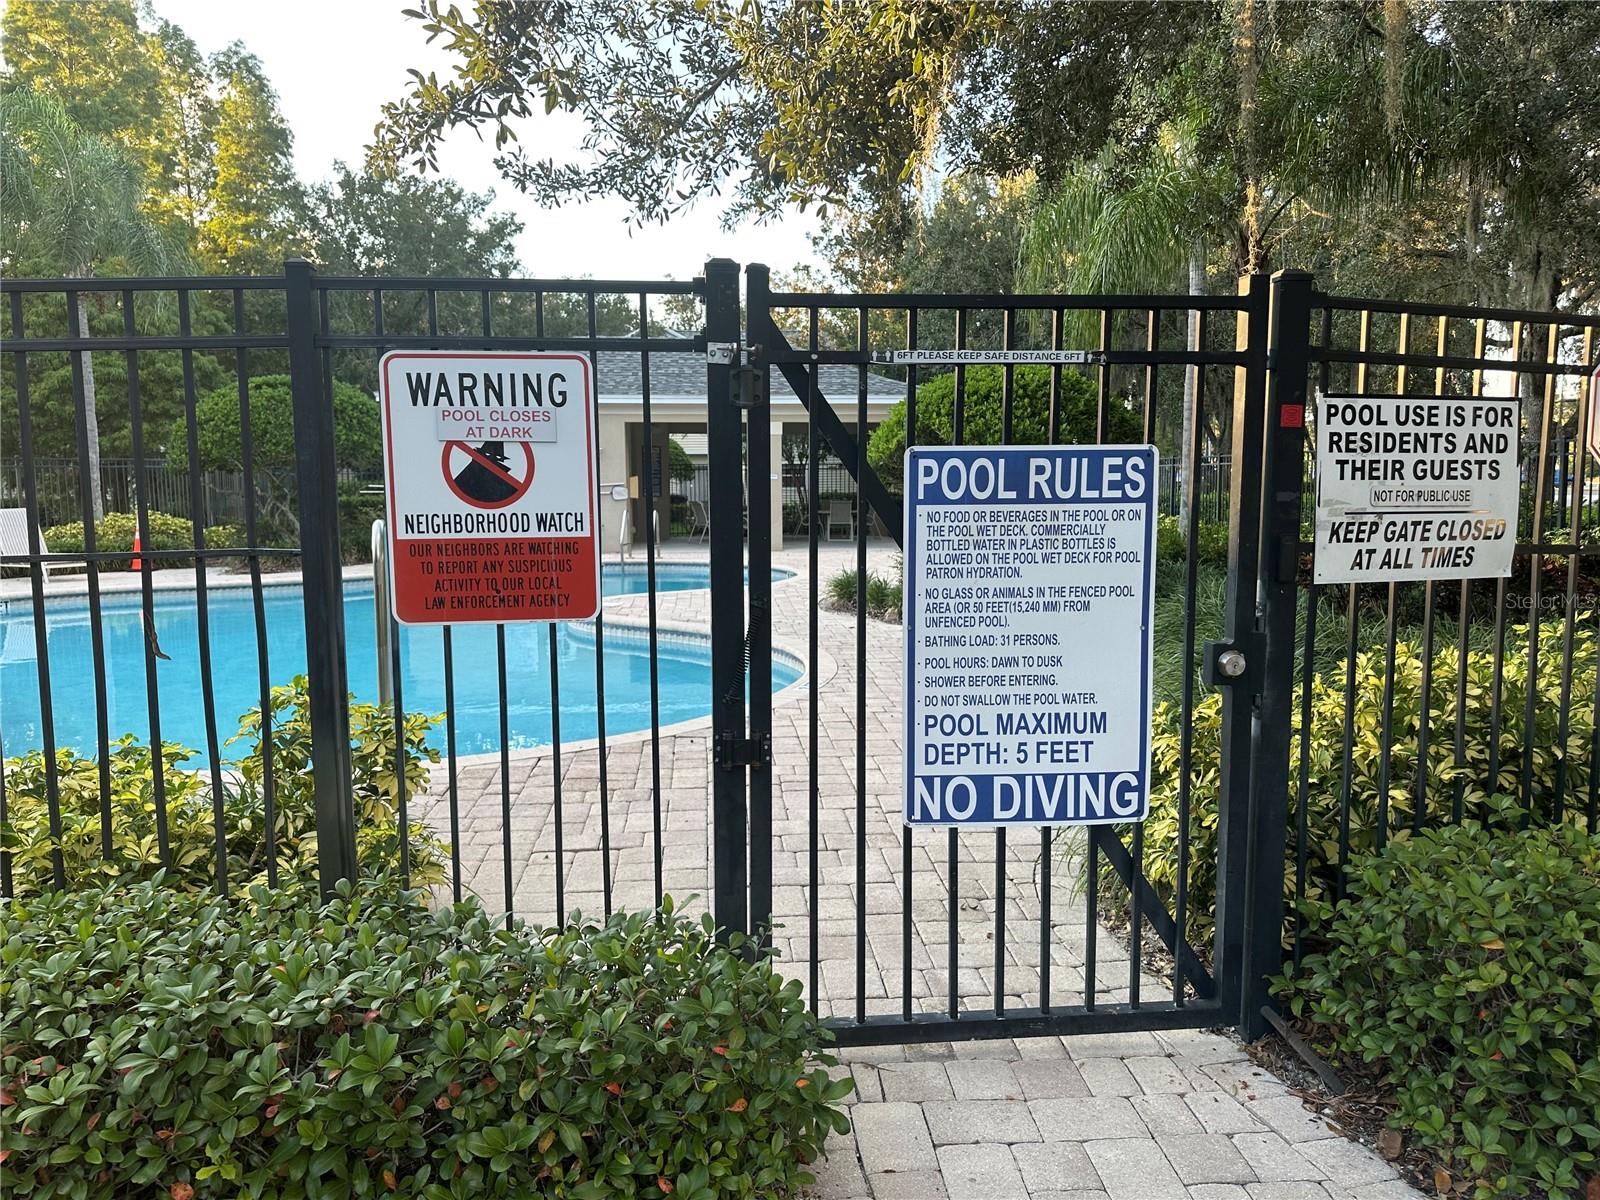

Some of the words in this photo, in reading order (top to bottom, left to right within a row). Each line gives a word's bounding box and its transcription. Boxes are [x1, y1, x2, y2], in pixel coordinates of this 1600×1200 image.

[897, 351, 914, 359] 6FT
[918, 351, 954, 360] PLEASE
[957, 352, 981, 360] KEEP
[984, 352, 1009, 360] SAFE
[1012, 352, 1061, 361] DISTANCE
[1064, 353, 1081, 361] 6FT
[406, 372, 567, 408] WARNING
[442, 410, 484, 422] POOL
[490, 411, 550, 422] CLOSES
[1326, 404, 1388, 426] POOL
[1395, 405, 1439, 426] USE
[1446, 406, 1465, 426] IS
[1472, 407, 1513, 427] FOR
[466, 427, 484, 438] AT
[490, 427, 532, 438] DARK
[1329, 432, 1456, 453] RESIDENTS
[1464, 433, 1508, 454] AND
[1336, 460, 1404, 480] THEIR
[1413, 460, 1500, 480] GUESTS
[918, 458, 1016, 500] POOL
[1028, 456, 1146, 499] RULES
[1374, 490, 1393, 502] NOT
[1396, 490, 1414, 502] FOR
[1417, 490, 1450, 502] PUBLIC
[1453, 490, 1470, 501] USE
[927, 511, 941, 522] NO
[944, 511, 969, 522] FOOD
[973, 511, 986, 522] OR
[990, 510, 1047, 522] BEVERAGES
[1050, 510, 1059, 521] IN
[1063, 510, 1080, 521] THE
[1083, 510, 1109, 521] POOL
[1112, 510, 1125, 521] OR
[1128, 509, 1141, 521] ON
[405, 513, 529, 534] NEIGHBORHOOD
[536, 512, 584, 532] WATCH
[927, 526, 945, 536] THE
[948, 525, 974, 536] POOL
[977, 525, 997, 536] WET
[1000, 525, 1027, 536] DECK.
[1031, 524, 1106, 536] COMMERCIALLY
[1329, 522, 1379, 543] KEEP
[1384, 520, 1433, 542] GATE
[1437, 519, 1506, 540] CLOSED
[410, 544, 432, 557] OUR
[437, 543, 499, 556] NEIGHBORS
[504, 543, 524, 555] ARE
[528, 542, 578, 555] WATCHING
[926, 540, 969, 551] BOTTLED
[973, 539, 1005, 550] WATER
[1008, 539, 1016, 550] IN
[1020, 539, 1059, 550] PLASTIC
[1062, 538, 1104, 549] BOTTLES
[1108, 538, 1115, 549] IS
[926, 553, 972, 565] ALLOWED
[975, 553, 989, 564] ON
[992, 553, 1010, 564] THE
[1013, 552, 1038, 564] POOL
[1041, 552, 1061, 564] WET
[1064, 552, 1090, 564] DECK
[1093, 552, 1112, 563] FOR
[1115, 551, 1140, 563] POOL
[1350, 549, 1376, 570] AT
[1380, 548, 1413, 569] ALL
[1421, 546, 1475, 567] TIMES
[421, 562, 432, 574] TO
[439, 561, 478, 574] REPORT
[483, 560, 503, 573] ANY
[509, 559, 572, 572] SUSPICIOUS
[926, 567, 963, 579] PATRON
[966, 567, 1022, 578] HYDRATION.
[435, 579, 480, 592] ACTIVITY
[485, 578, 497, 590] TO
[503, 578, 524, 590] OUR
[529, 577, 562, 589] LOCAL
[925, 588, 939, 599] NO
[942, 588, 973, 599] GLASS
[976, 588, 989, 598] OR
[992, 587, 1033, 598] ANIMALS
[1036, 587, 1045, 598] IN
[1048, 586, 1066, 598] THE
[1069, 586, 1106, 598] FENCED
[1109, 586, 1134, 597] POOL
[425, 598, 445, 609] LAW
[451, 595, 525, 608] ENFORCEMENT
[529, 594, 570, 607] AGENCY
[925, 602, 951, 613] AREA
[954, 601, 970, 614] (OR
[973, 602, 983, 613] 50
[1043, 601, 1061, 613] MM)
[1064, 600, 1090, 612] FROM
[925, 616, 975, 628] UNFENCED
[978, 616, 1010, 628] POOL).
[925, 636, 966, 647] BATHING
[969, 635, 998, 647] LOAD:
[1000, 635, 1010, 646] 31
[1014, 634, 1060, 646] PERSONS.
[925, 657, 950, 669] POOL
[953, 657, 989, 668] HOURS:
[992, 657, 1019, 668] DAWN
[1022, 656, 1034, 667] TO
[1037, 656, 1063, 667] DUSK
[925, 676, 965, 688] SHOWER
[969, 676, 1006, 687] BEFORE
[1009, 675, 1058, 686] ENTERING.
[925, 696, 938, 707] DO
[941, 695, 960, 706] NOT
[963, 694, 1010, 706] SWALLOW
[1013, 694, 1031, 705] THE
[1034, 694, 1059, 705] POOL
[1062, 693, 1097, 704] WATER.
[925, 714, 988, 736] POOL
[997, 712, 1107, 735] MAXIMUM
[925, 742, 1008, 765] DEPTH:
[1016, 742, 1028, 764] 5
[1036, 741, 1093, 763] FEET
[914, 776, 977, 820] NO
[994, 773, 1139, 820] DIVING
